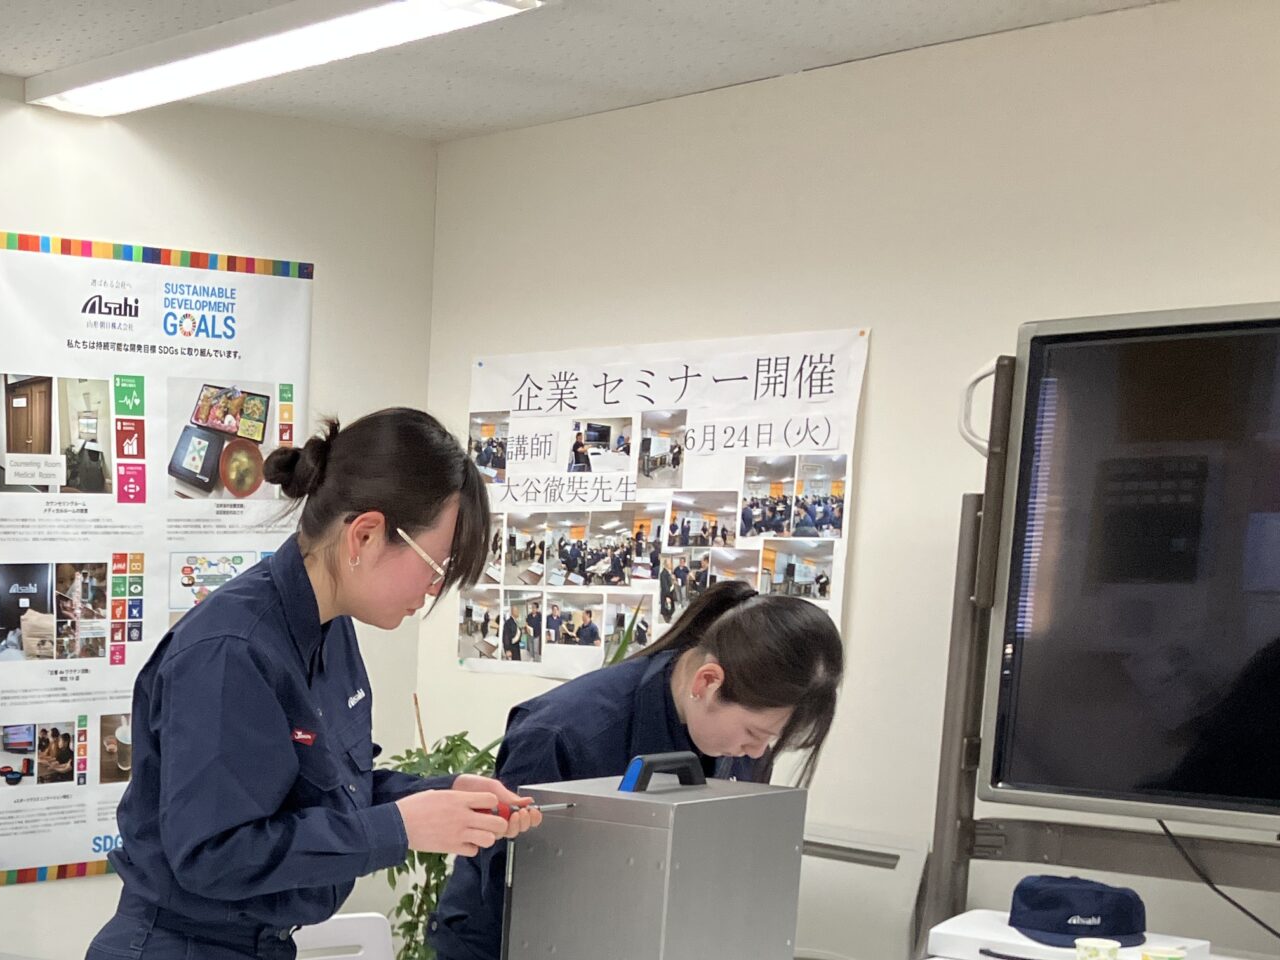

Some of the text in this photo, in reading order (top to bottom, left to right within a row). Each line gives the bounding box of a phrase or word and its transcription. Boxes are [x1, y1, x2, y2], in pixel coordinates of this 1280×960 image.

[164, 282, 237, 300] SUSTAINABLE
[81, 295, 139, 318] Asahi
[163, 297, 236, 314] DEVELOPMENT
[86, 320, 134, 332] 山形朝日株式会社
[163, 311, 236, 340] GOALS
[66, 338, 242, 360] 私たちは持続可能な開発目標 SDGs に取り組んでいます。
[506, 432, 553, 461] 講師
[9, 583, 37, 593] Asahi
